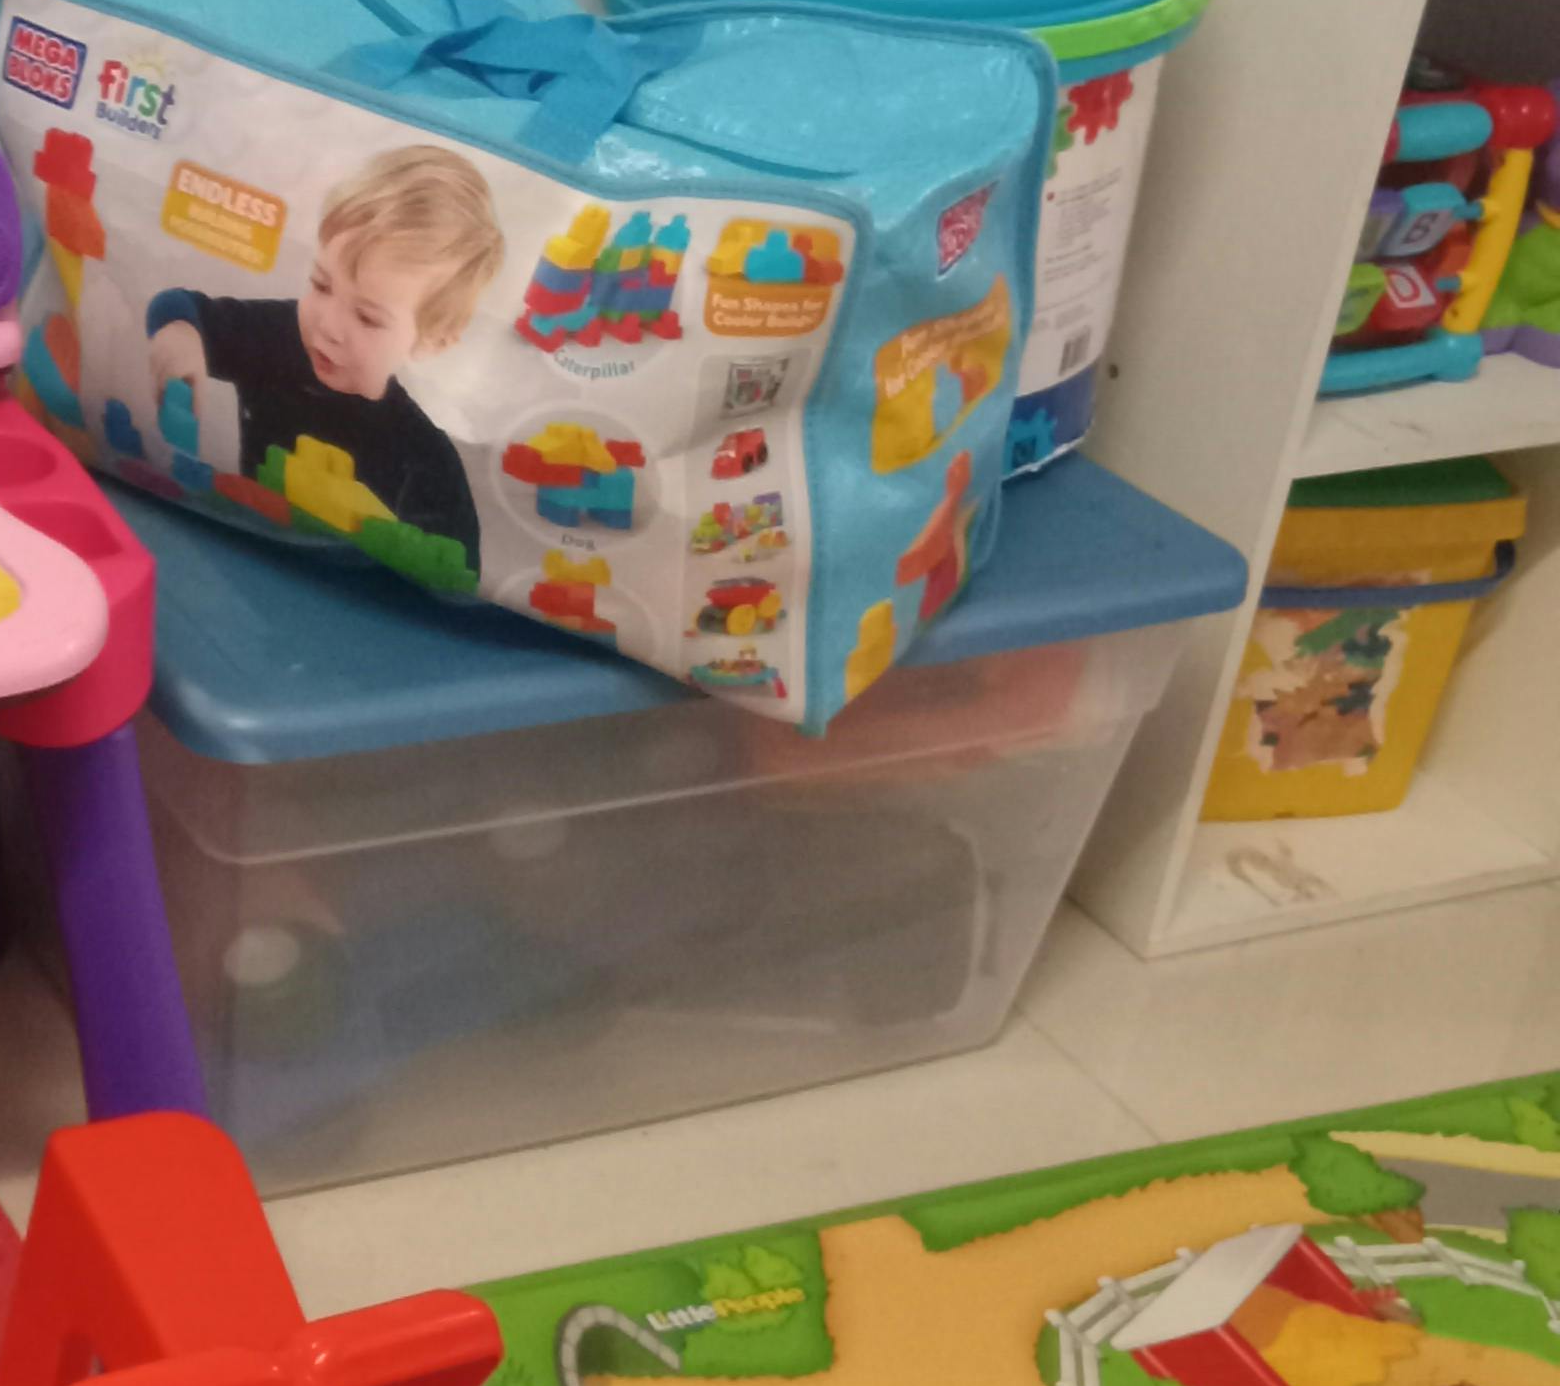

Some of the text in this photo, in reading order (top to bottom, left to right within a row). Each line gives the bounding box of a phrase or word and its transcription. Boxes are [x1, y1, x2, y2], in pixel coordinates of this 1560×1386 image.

[13, 24, 78, 72] MEGA
[6, 53, 72, 101] BLOKS
[98, 59, 175, 125] first
[96, 102, 161, 139] Builders
[178, 168, 278, 226] ENDLESS
[553, 348, 638, 381] Caterpillar
[562, 533, 597, 552] Dog
